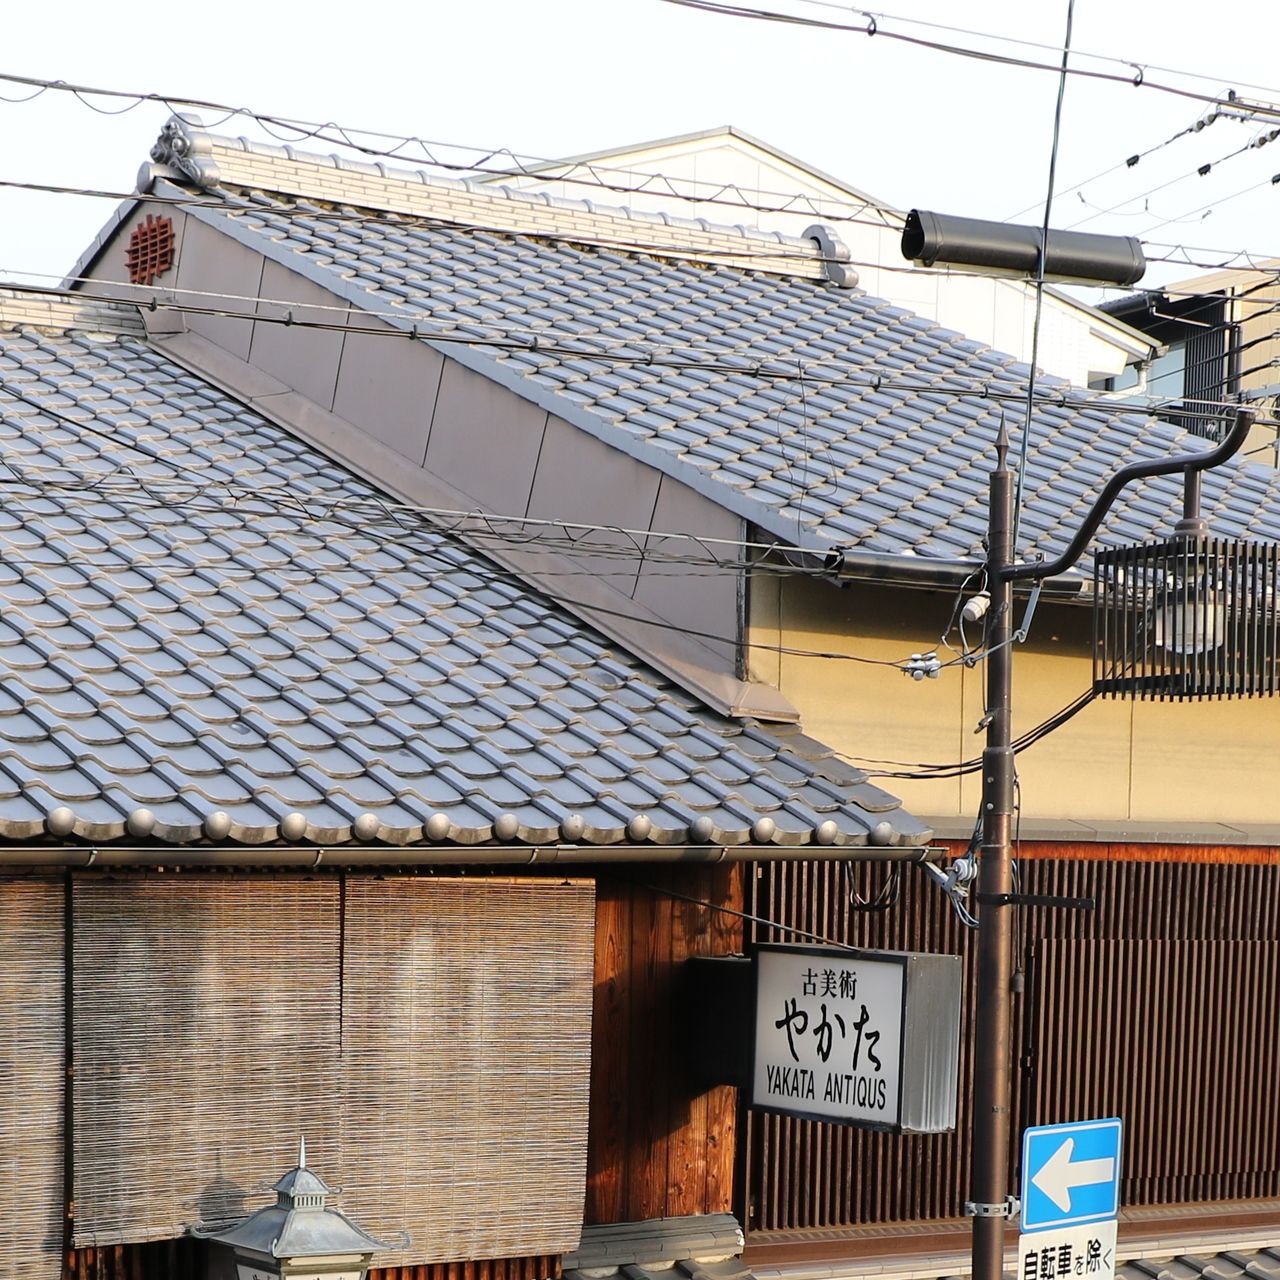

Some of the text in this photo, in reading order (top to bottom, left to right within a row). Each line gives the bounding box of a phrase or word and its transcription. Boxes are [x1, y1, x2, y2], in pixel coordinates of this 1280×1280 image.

[802, 968, 858, 1000] 古美術
[775, 998, 881, 1072] やかた
[766, 1065, 887, 1112] YAKATA ANTIQUS
